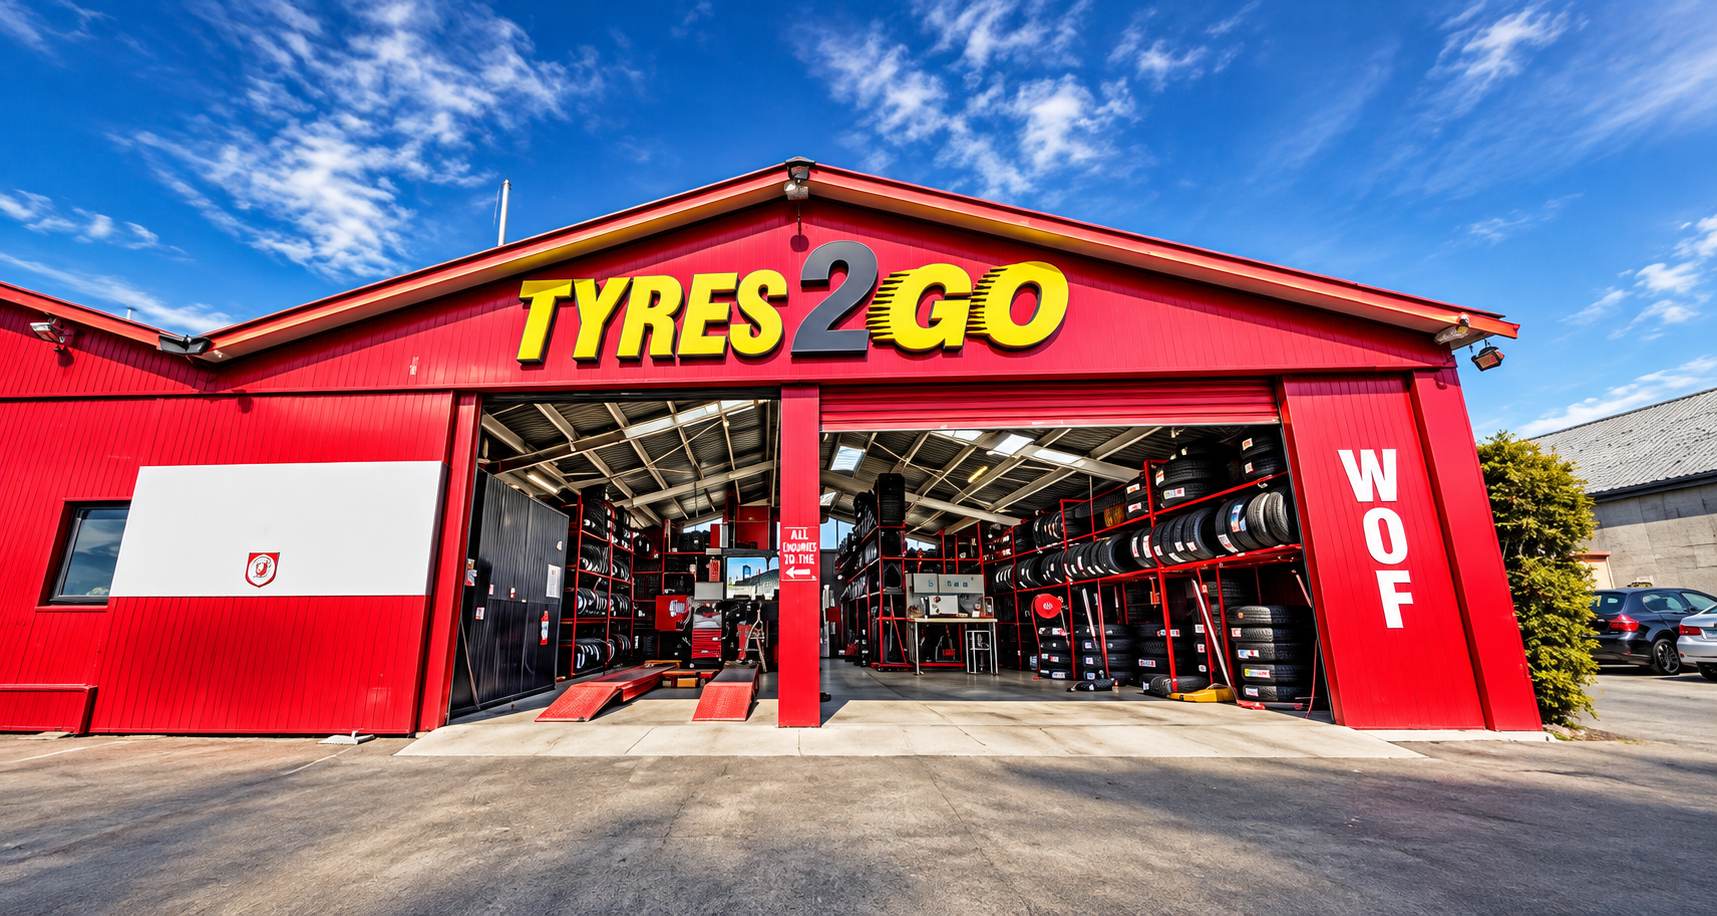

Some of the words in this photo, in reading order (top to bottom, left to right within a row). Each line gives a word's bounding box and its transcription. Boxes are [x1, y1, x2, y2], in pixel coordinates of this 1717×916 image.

[790, 529, 809, 540] ALL
[1337, 449, 1414, 629] WOF
[784, 553, 795, 565] TO
[798, 553, 815, 565] THE
